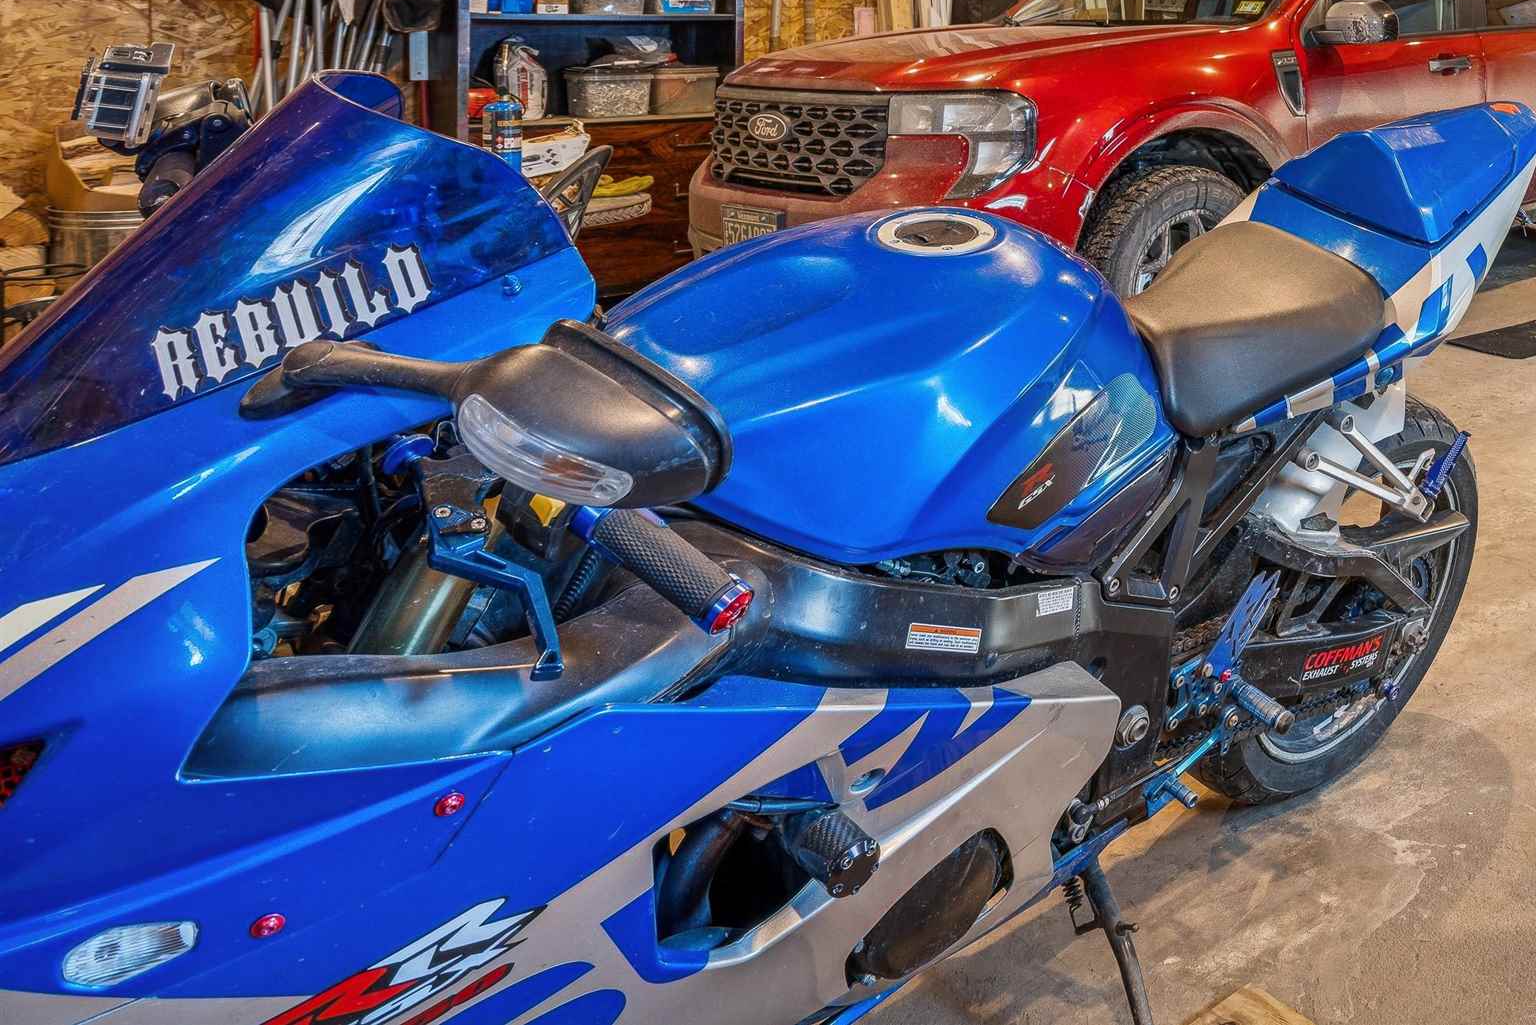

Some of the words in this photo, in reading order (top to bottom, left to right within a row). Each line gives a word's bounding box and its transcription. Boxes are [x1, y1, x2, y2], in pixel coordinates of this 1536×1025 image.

[753, 117, 779, 137] Ford
[152, 244, 432, 401] REBUILD
[1302, 664, 1340, 681] EXHAUST
[1349, 651, 1378, 670] SYSTEMS
[1304, 634, 1383, 670] COFFMAN'S
